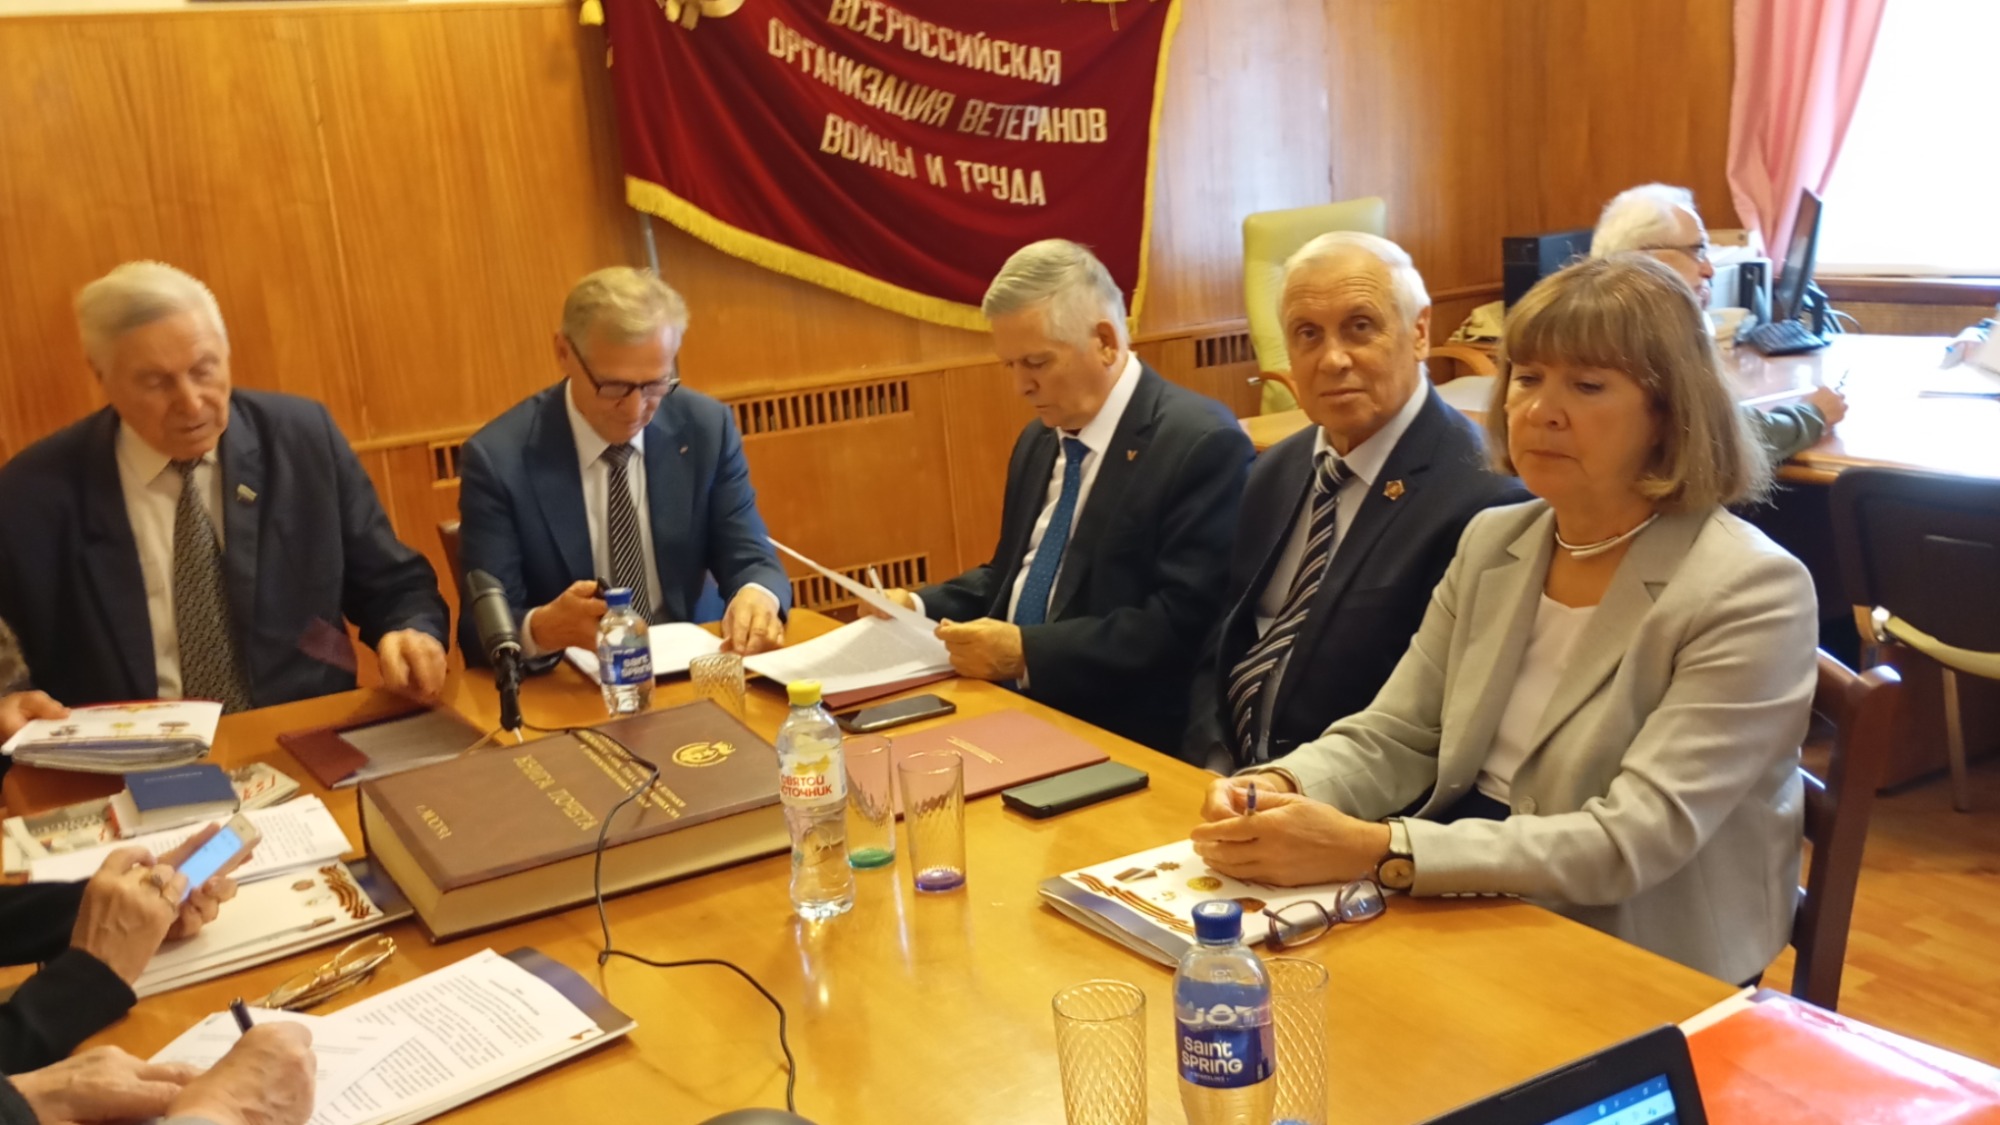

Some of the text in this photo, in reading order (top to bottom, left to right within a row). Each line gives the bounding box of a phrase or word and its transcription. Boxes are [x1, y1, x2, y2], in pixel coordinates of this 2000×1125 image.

[768, 17, 1107, 143] ОРГАНИЗАЦИЯ ВЕТЕРАНОВ
[827, 0, 1062, 86] ВСЕРОССИЙСКАЯ
[820, 113, 1047, 206] ВОЙНЫ И ТРУДА
[781, 783, 833, 798] СТОЧНИК
